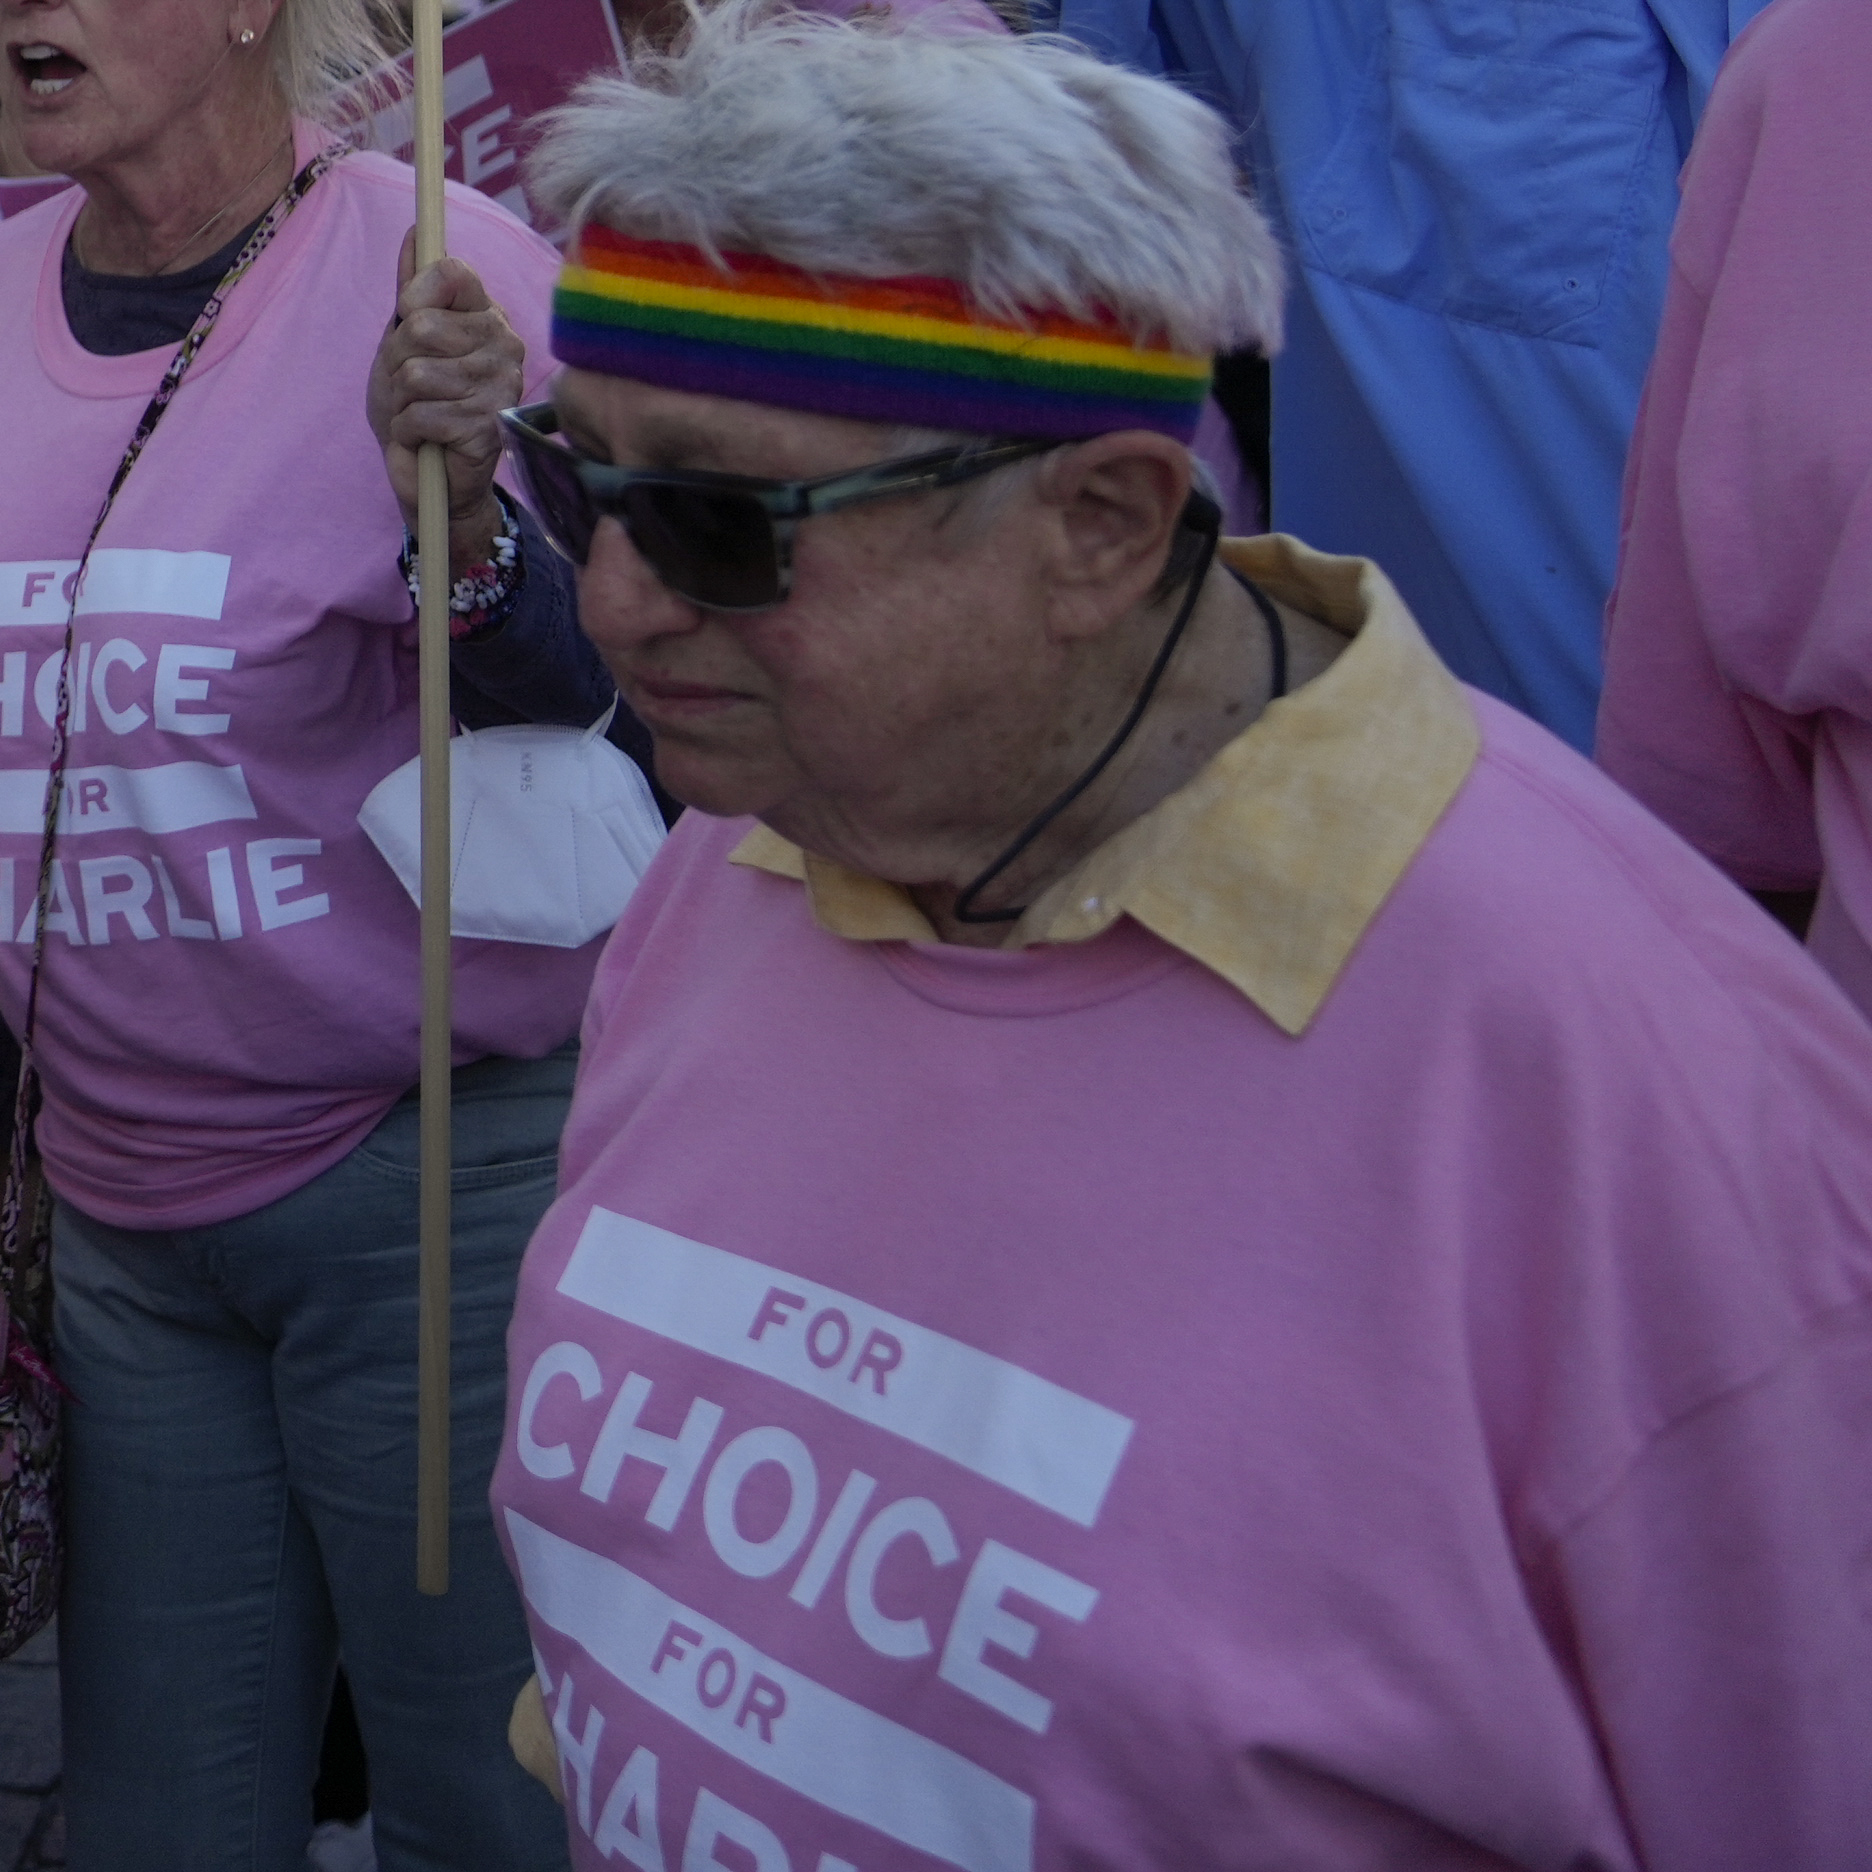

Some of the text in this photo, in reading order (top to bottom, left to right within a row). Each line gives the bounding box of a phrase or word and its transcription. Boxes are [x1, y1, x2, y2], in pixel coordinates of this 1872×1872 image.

[746, 1285, 904, 1396] FOR
[516, 1341, 1101, 1734] CHOICE
[649, 1619, 789, 1745] FOR
